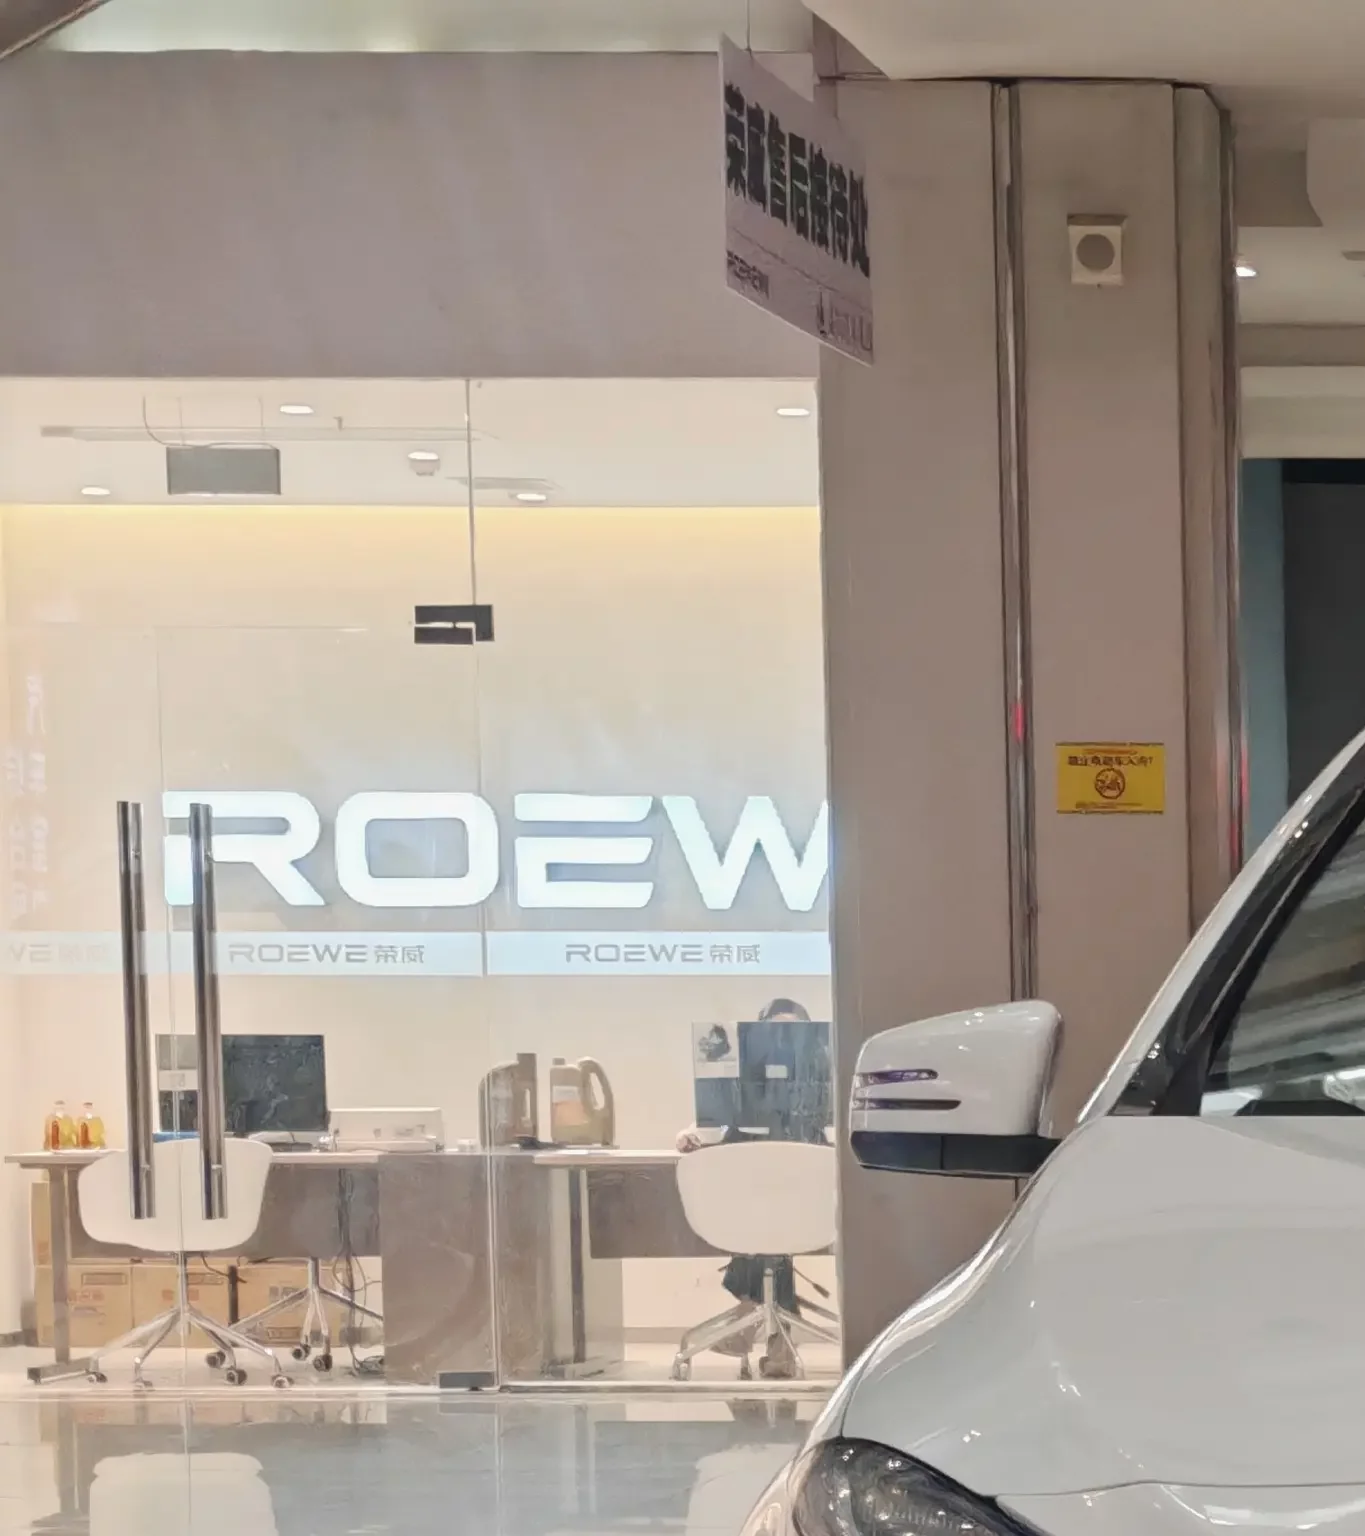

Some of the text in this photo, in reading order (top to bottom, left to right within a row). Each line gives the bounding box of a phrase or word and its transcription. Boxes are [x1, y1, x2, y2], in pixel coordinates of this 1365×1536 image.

[163, 790, 829, 911] ROEW
[228, 944, 425, 964] ROEWE 荣威
[565, 944, 760, 964] ROEWE 荣威
